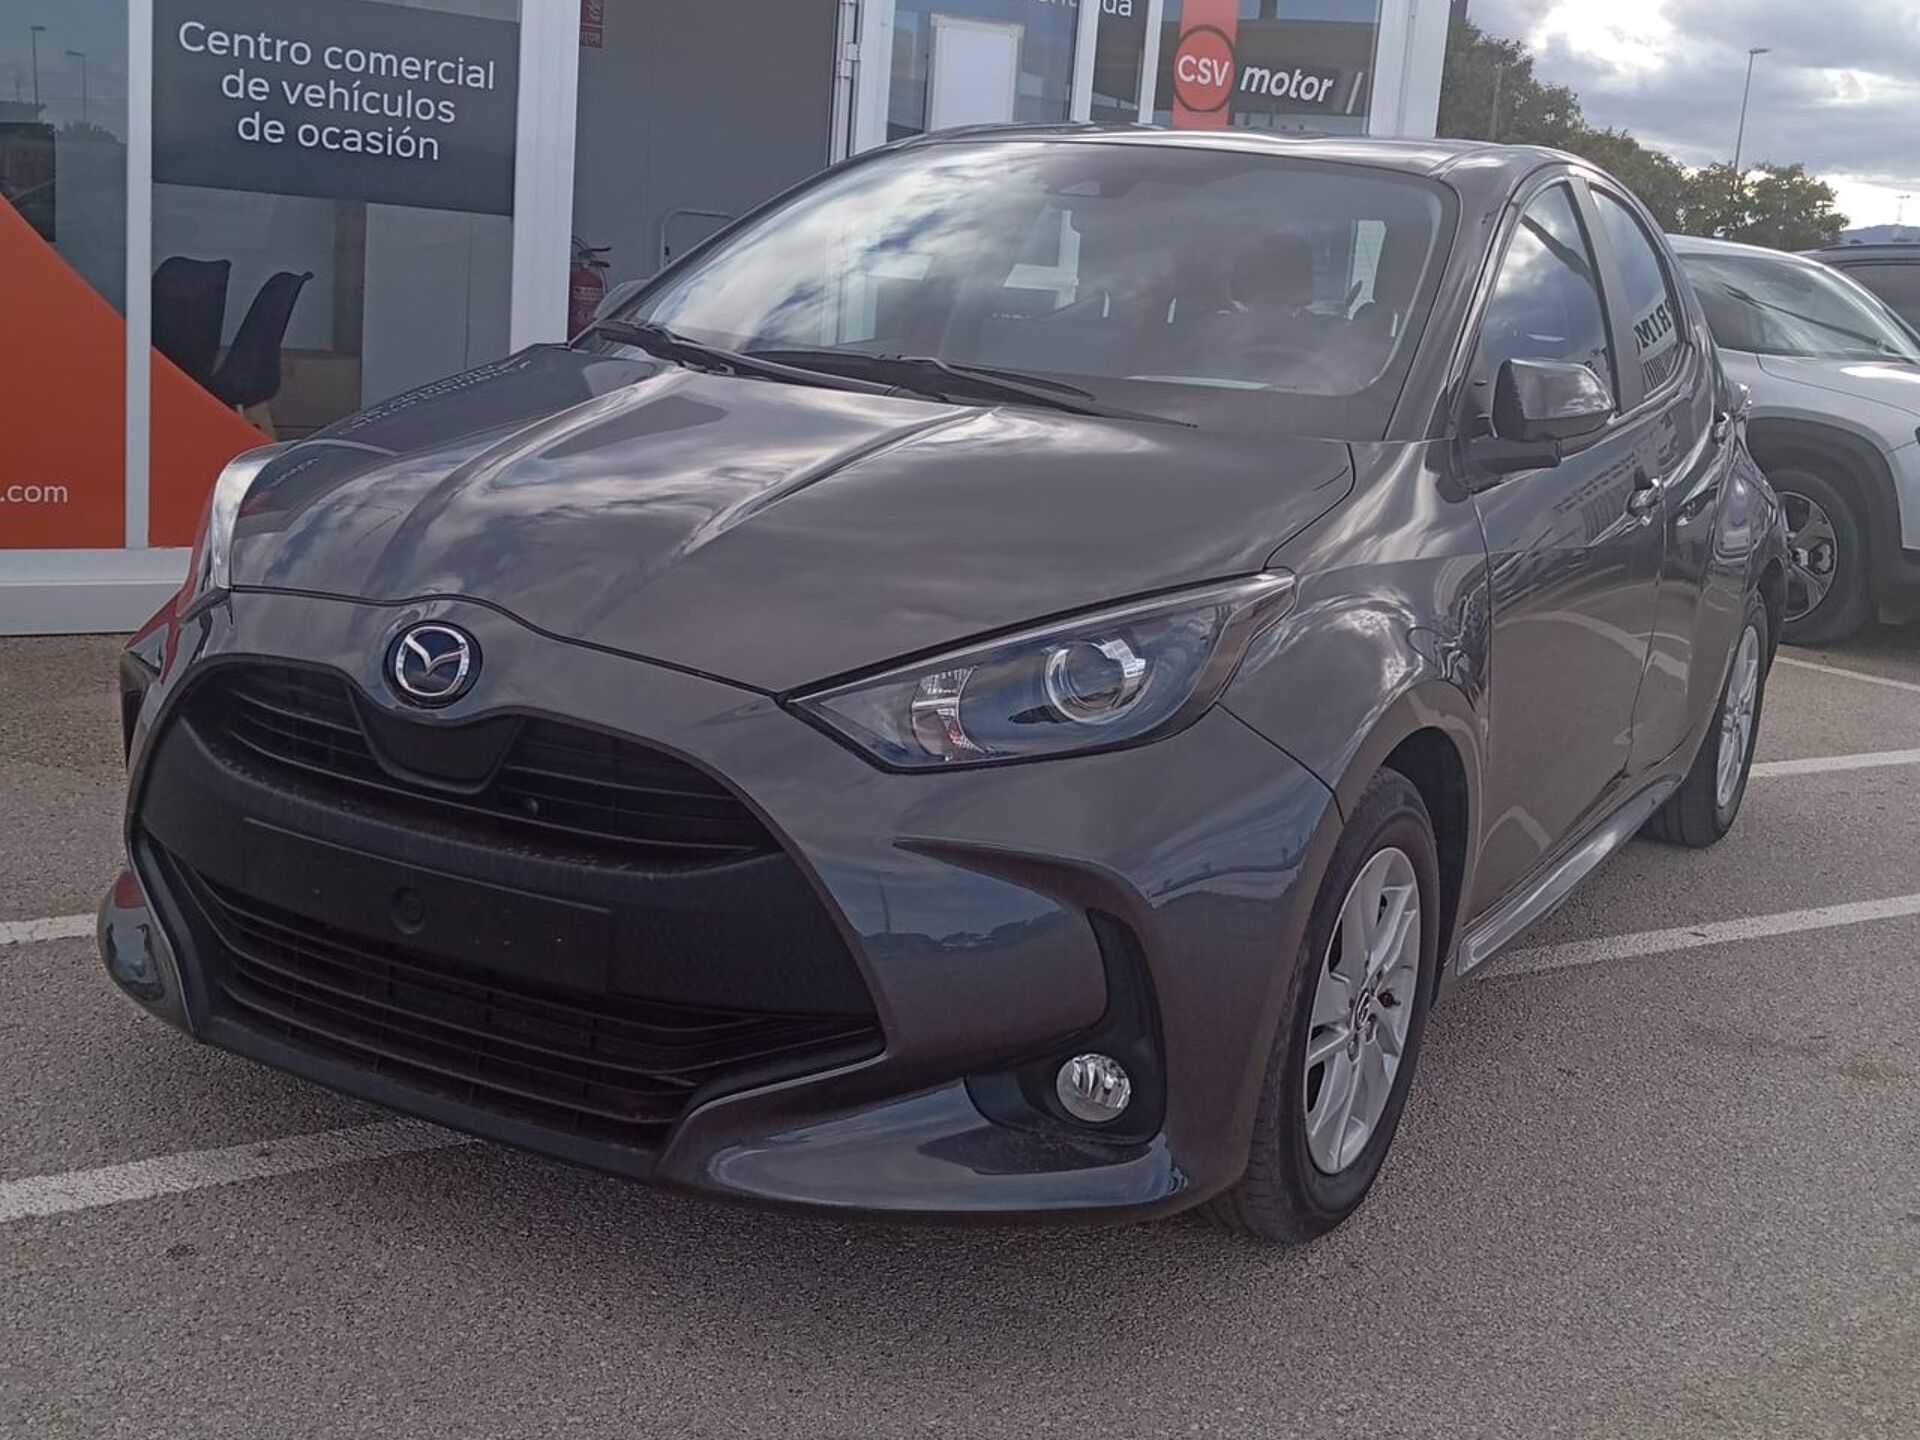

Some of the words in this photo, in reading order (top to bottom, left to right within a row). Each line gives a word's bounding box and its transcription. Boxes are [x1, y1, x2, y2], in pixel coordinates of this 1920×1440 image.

[178, 21, 312, 67] Centro
[323, 45, 496, 90] comercial
[1177, 55, 1230, 87] CSV
[1240, 66, 1334, 103] motor
[221, 69, 271, 101] de
[281, 79, 457, 124] vehículos
[237, 112, 286, 143] de
[297, 123, 440, 160] ocasión
[0, 485, 69, 502] .com
